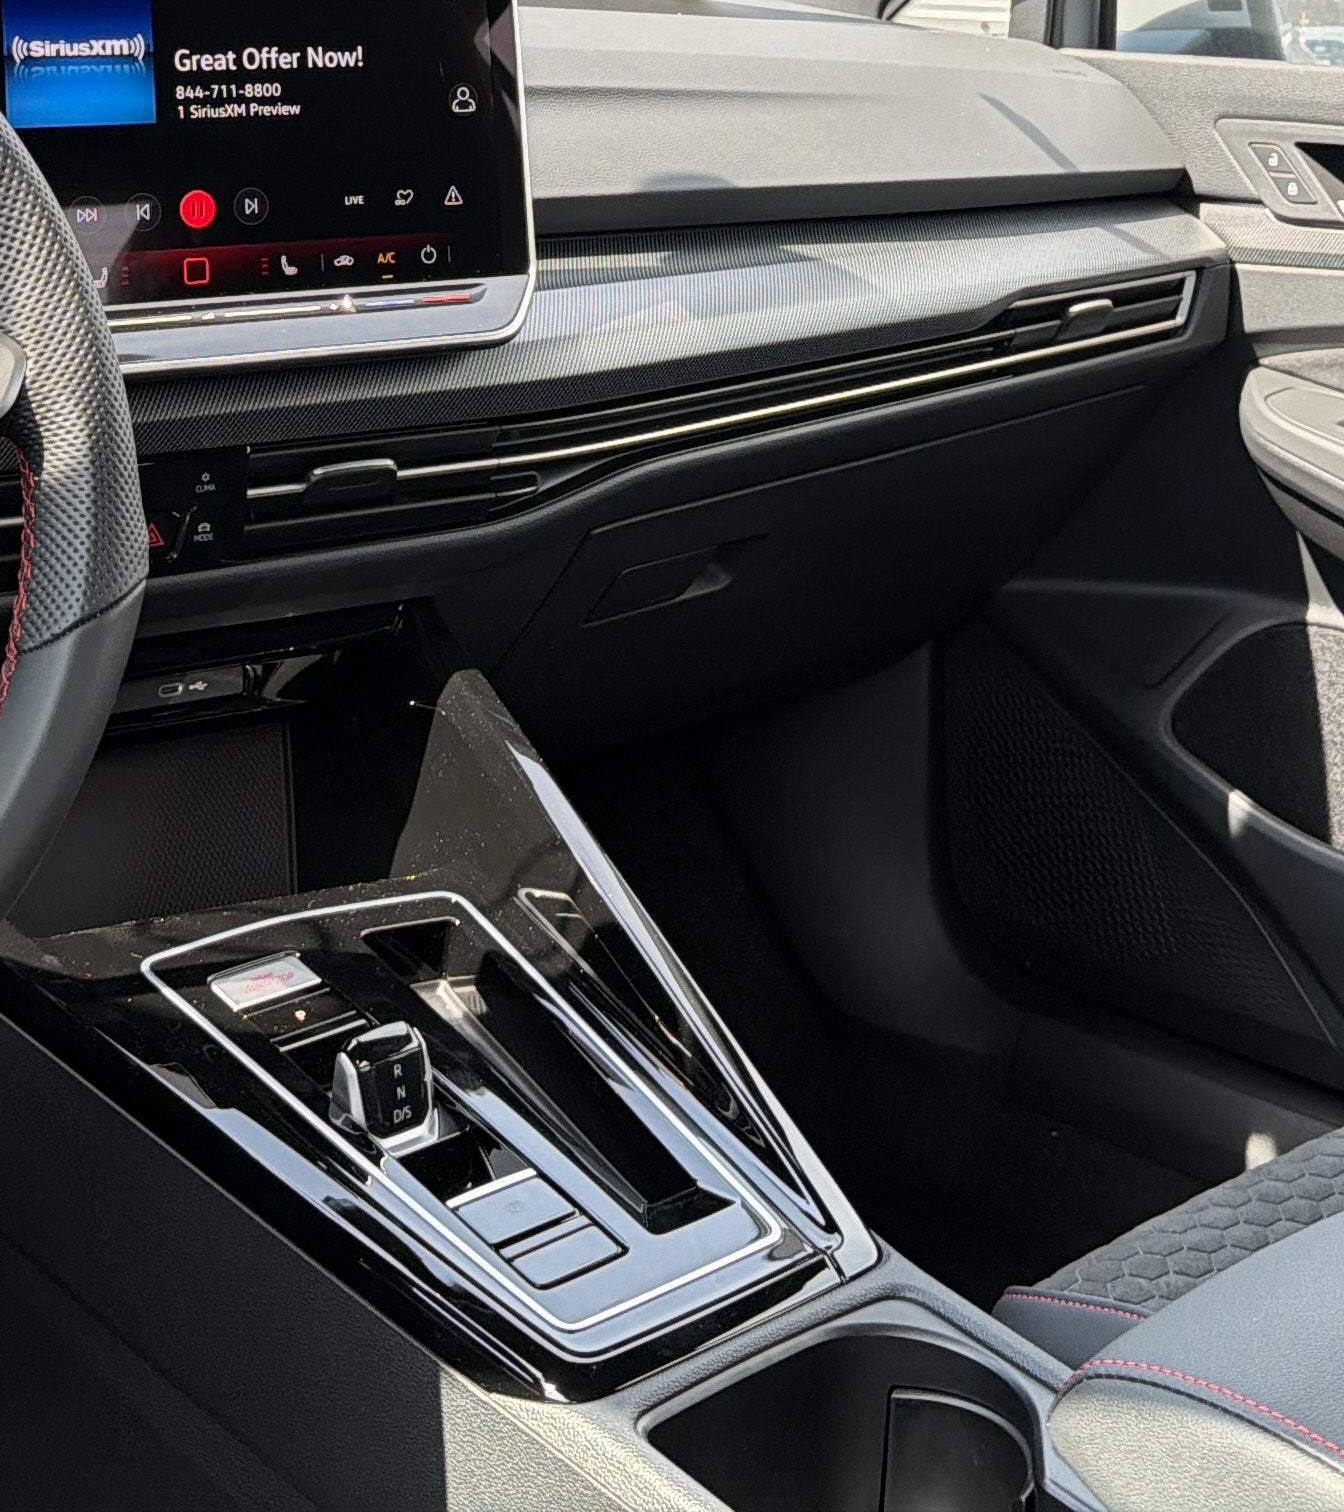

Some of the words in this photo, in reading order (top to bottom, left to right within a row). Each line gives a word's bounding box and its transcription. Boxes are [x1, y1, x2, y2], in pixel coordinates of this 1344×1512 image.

[174, 48, 237, 71] Great
[242, 46, 301, 70] Offer
[307, 45, 364, 68] Now!
[175, 82, 282, 100] 844-711-8800
[177, 105, 184, 119] 1
[190, 103, 247, 119] SiriusXM
[249, 102, 301, 117] Preview
[344, 195, 365, 205] LIVE
[377, 252, 396, 264] A/C
[195, 483, 216, 494] CLIMA
[193, 533, 214, 543] MODE
[393, 1063, 402, 1078] R
[397, 1085, 406, 1100] N
[393, 1105, 412, 1124] D/S
